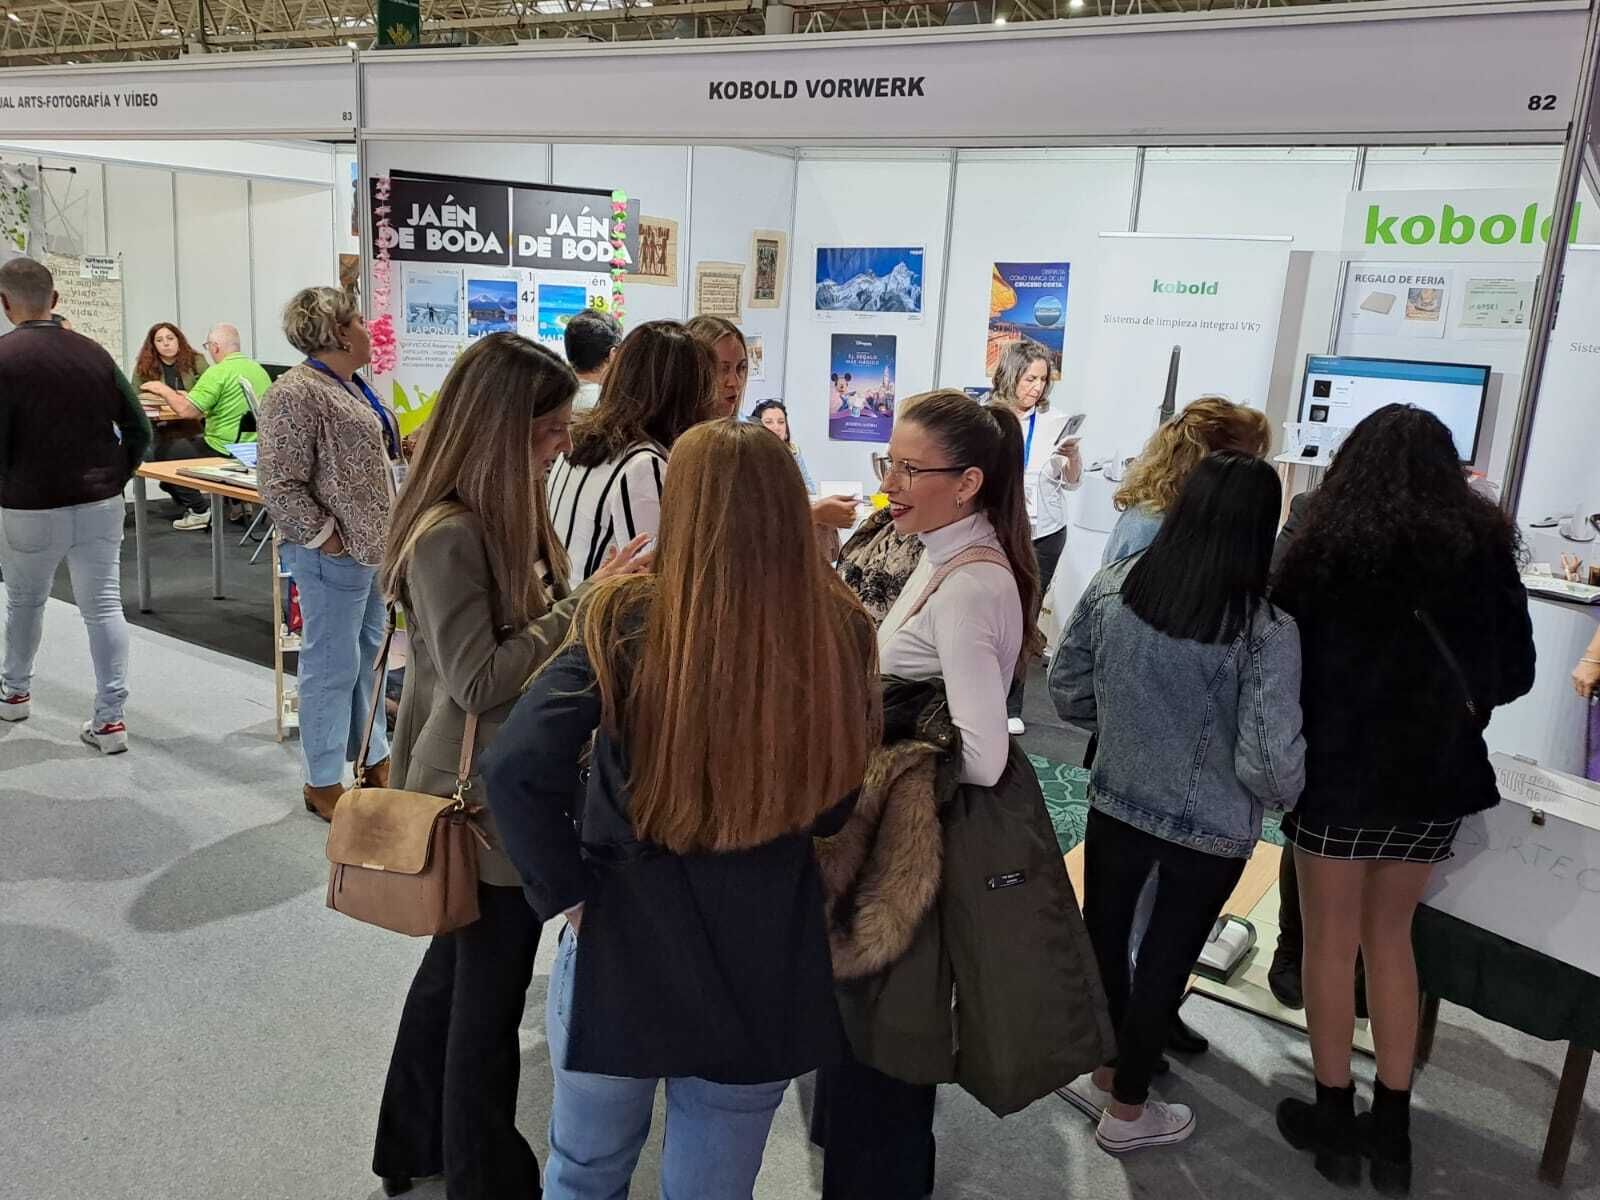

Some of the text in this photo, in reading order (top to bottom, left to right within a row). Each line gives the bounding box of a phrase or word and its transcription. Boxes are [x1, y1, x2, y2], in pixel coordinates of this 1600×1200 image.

[708, 77, 926, 100] KOBOLD VORWERK
[17, 91, 111, 109] ARTS-FOTOGRAFÍA
[113, 94, 121, 107] Y
[123, 90, 158, 107] VÍDEO
[1527, 94, 1557, 111] 82
[342, 111, 353, 121] 83
[406, 194, 477, 230] JAÉN
[544, 206, 609, 241] JAÉN
[1364, 201, 1582, 245] kobold
[426, 228, 504, 254] BODA
[518, 235, 552, 258] DE
[1152, 279, 1219, 296] kobold
[1354, 273, 1446, 286] REGALO DE FERIA
[410, 325, 455, 336] LAPONIA
[1103, 313, 1262, 333] Sistema de limpieza integral VK7
